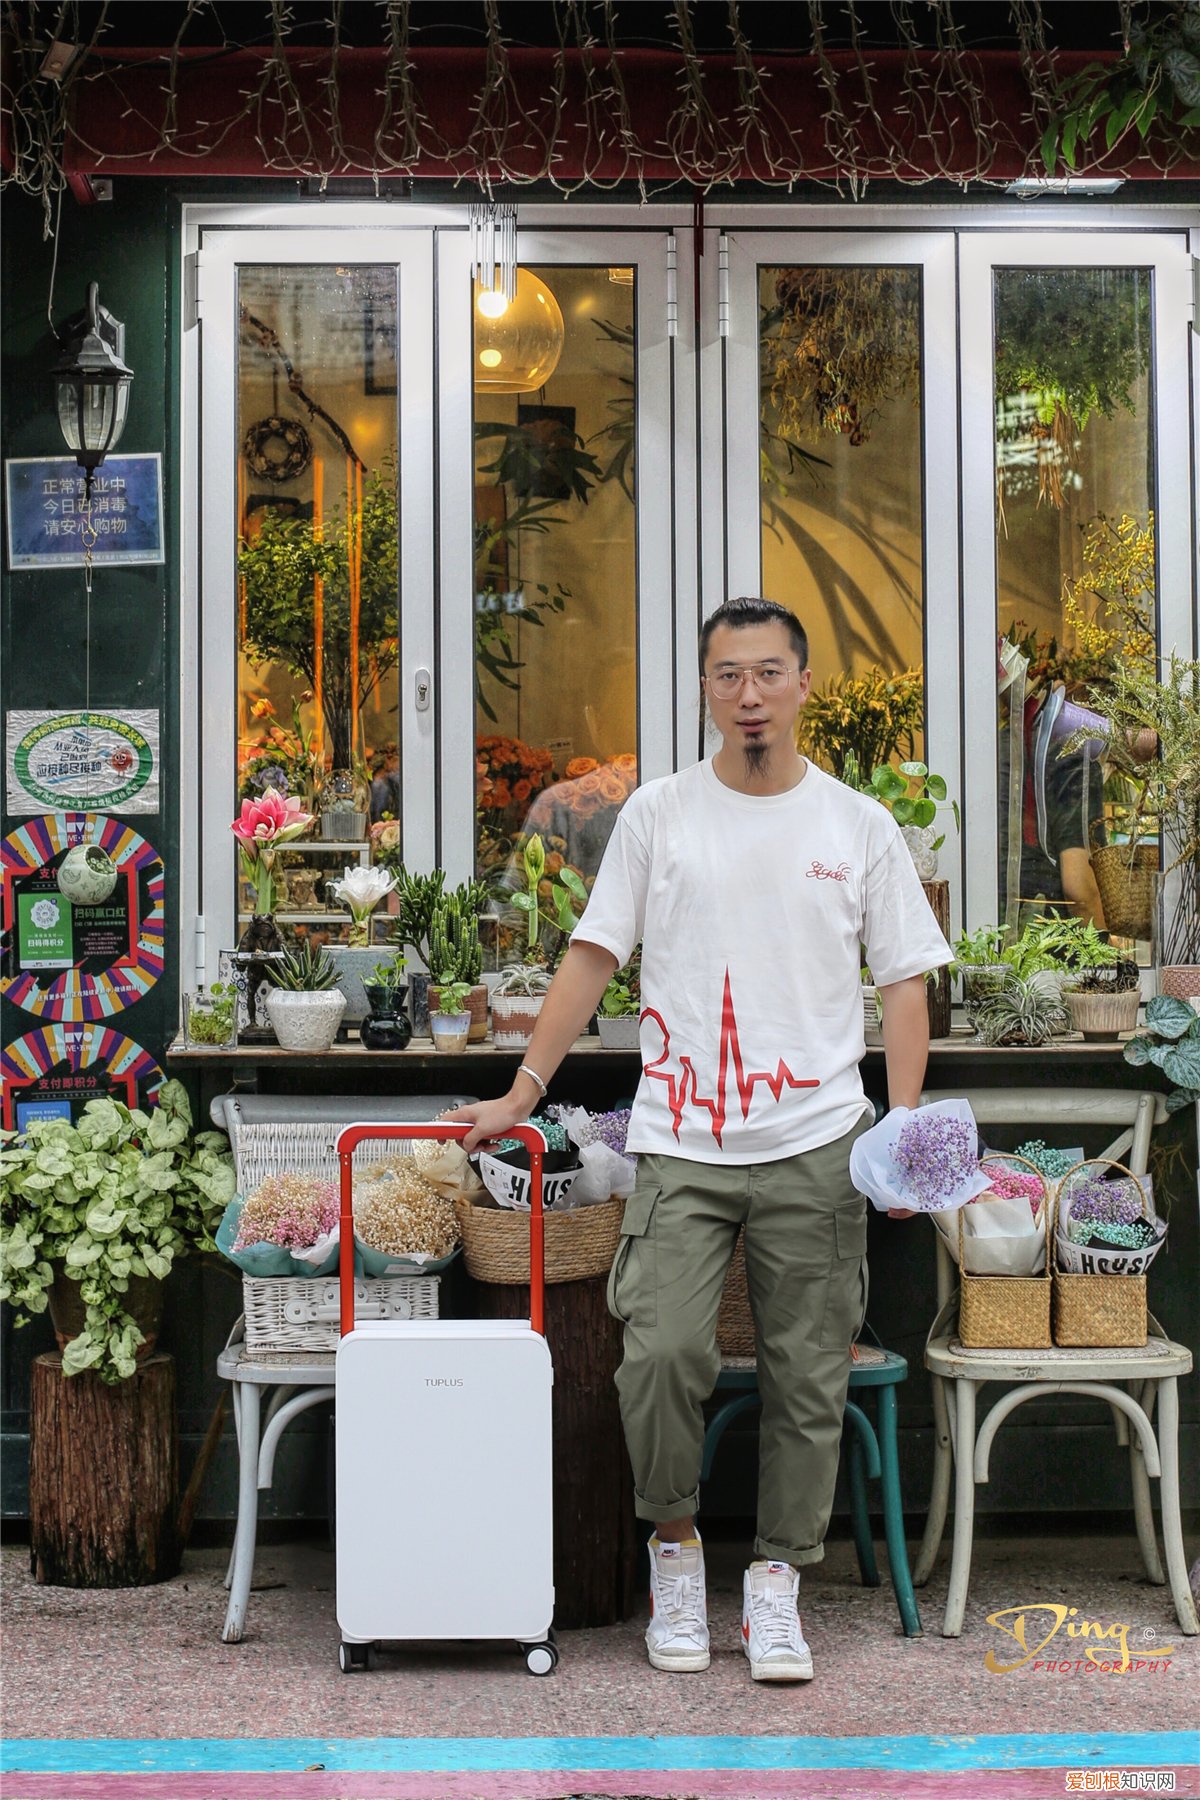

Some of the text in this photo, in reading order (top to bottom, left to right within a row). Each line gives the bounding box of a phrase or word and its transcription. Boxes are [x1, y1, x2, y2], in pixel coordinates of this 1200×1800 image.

[42, 477, 126, 495] 正常营业中
[43, 497, 127, 515] 今日已消毒
[44, 518, 127, 537] 请安心购物
[36, 761, 102, 778] 应接种尽接种
[74, 906, 126, 919] 扫码赢口红
[38, 1076, 97, 1090] 支付即积分
[508, 1175, 578, 1206] HUS
[423, 1378, 464, 1387] TUPLUS
